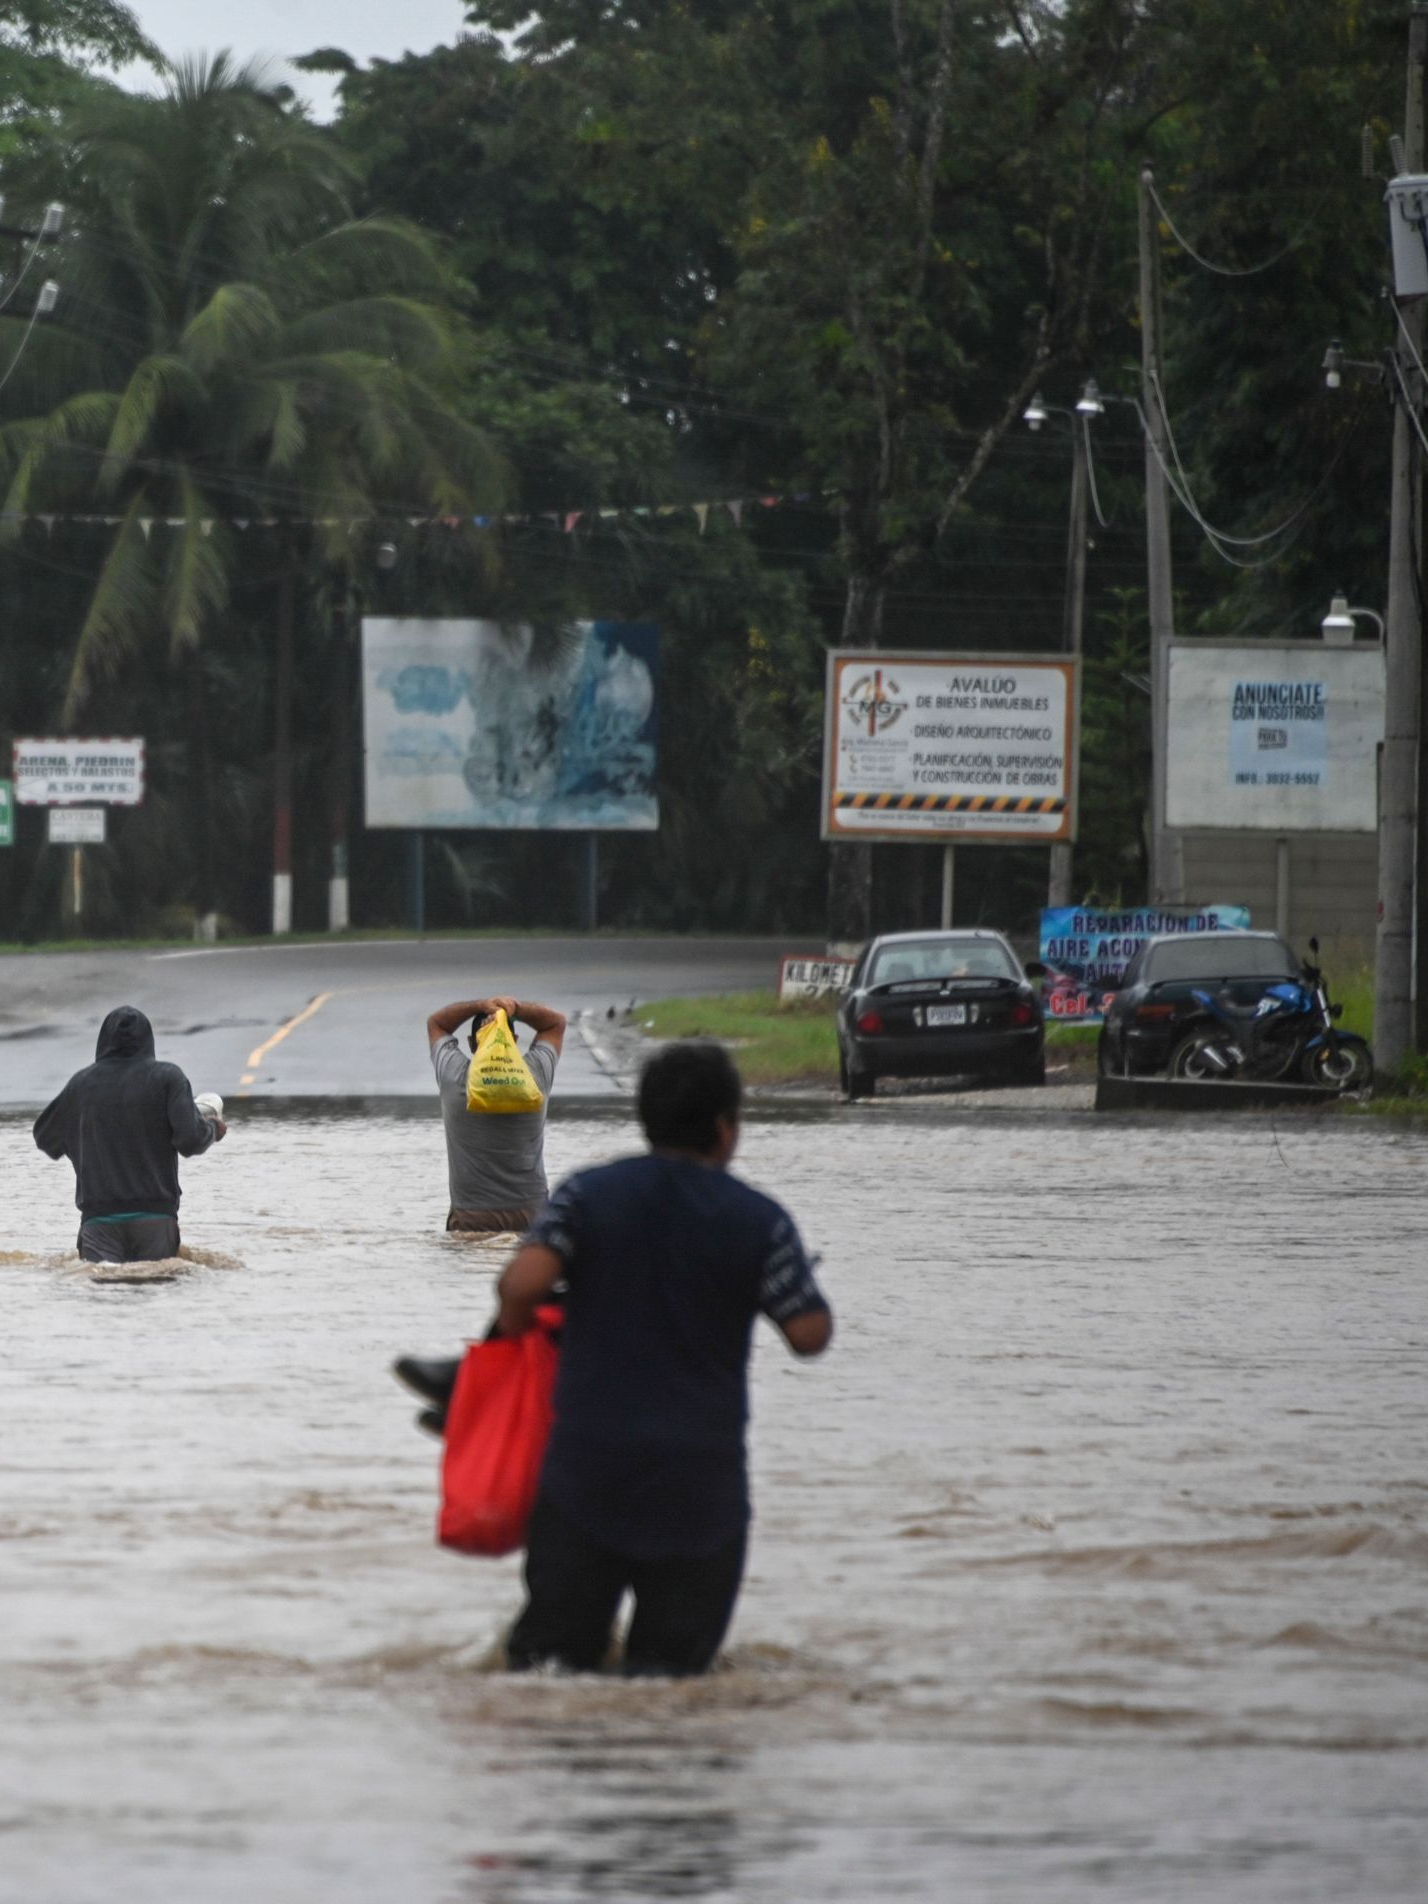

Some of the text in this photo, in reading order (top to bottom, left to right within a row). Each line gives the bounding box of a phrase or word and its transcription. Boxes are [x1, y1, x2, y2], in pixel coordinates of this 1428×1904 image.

[950, 675, 1017, 694] AVALÚO
[916, 695, 1049, 711] DE BIENES INMUEBLES
[1234, 683, 1323, 705] ANUNCIATE
[1232, 704, 1255, 721] CON
[914, 723, 1052, 741] DISEÑO ARQUITECTÓNICO
[996, 753, 1063, 769] SUPERVISIÓN
[912, 769, 1057, 786] Y CONSTRUCCIÓN DE OBRAS
[1196, 912, 1219, 931] DE
[1047, 938, 1090, 958] AIRE
